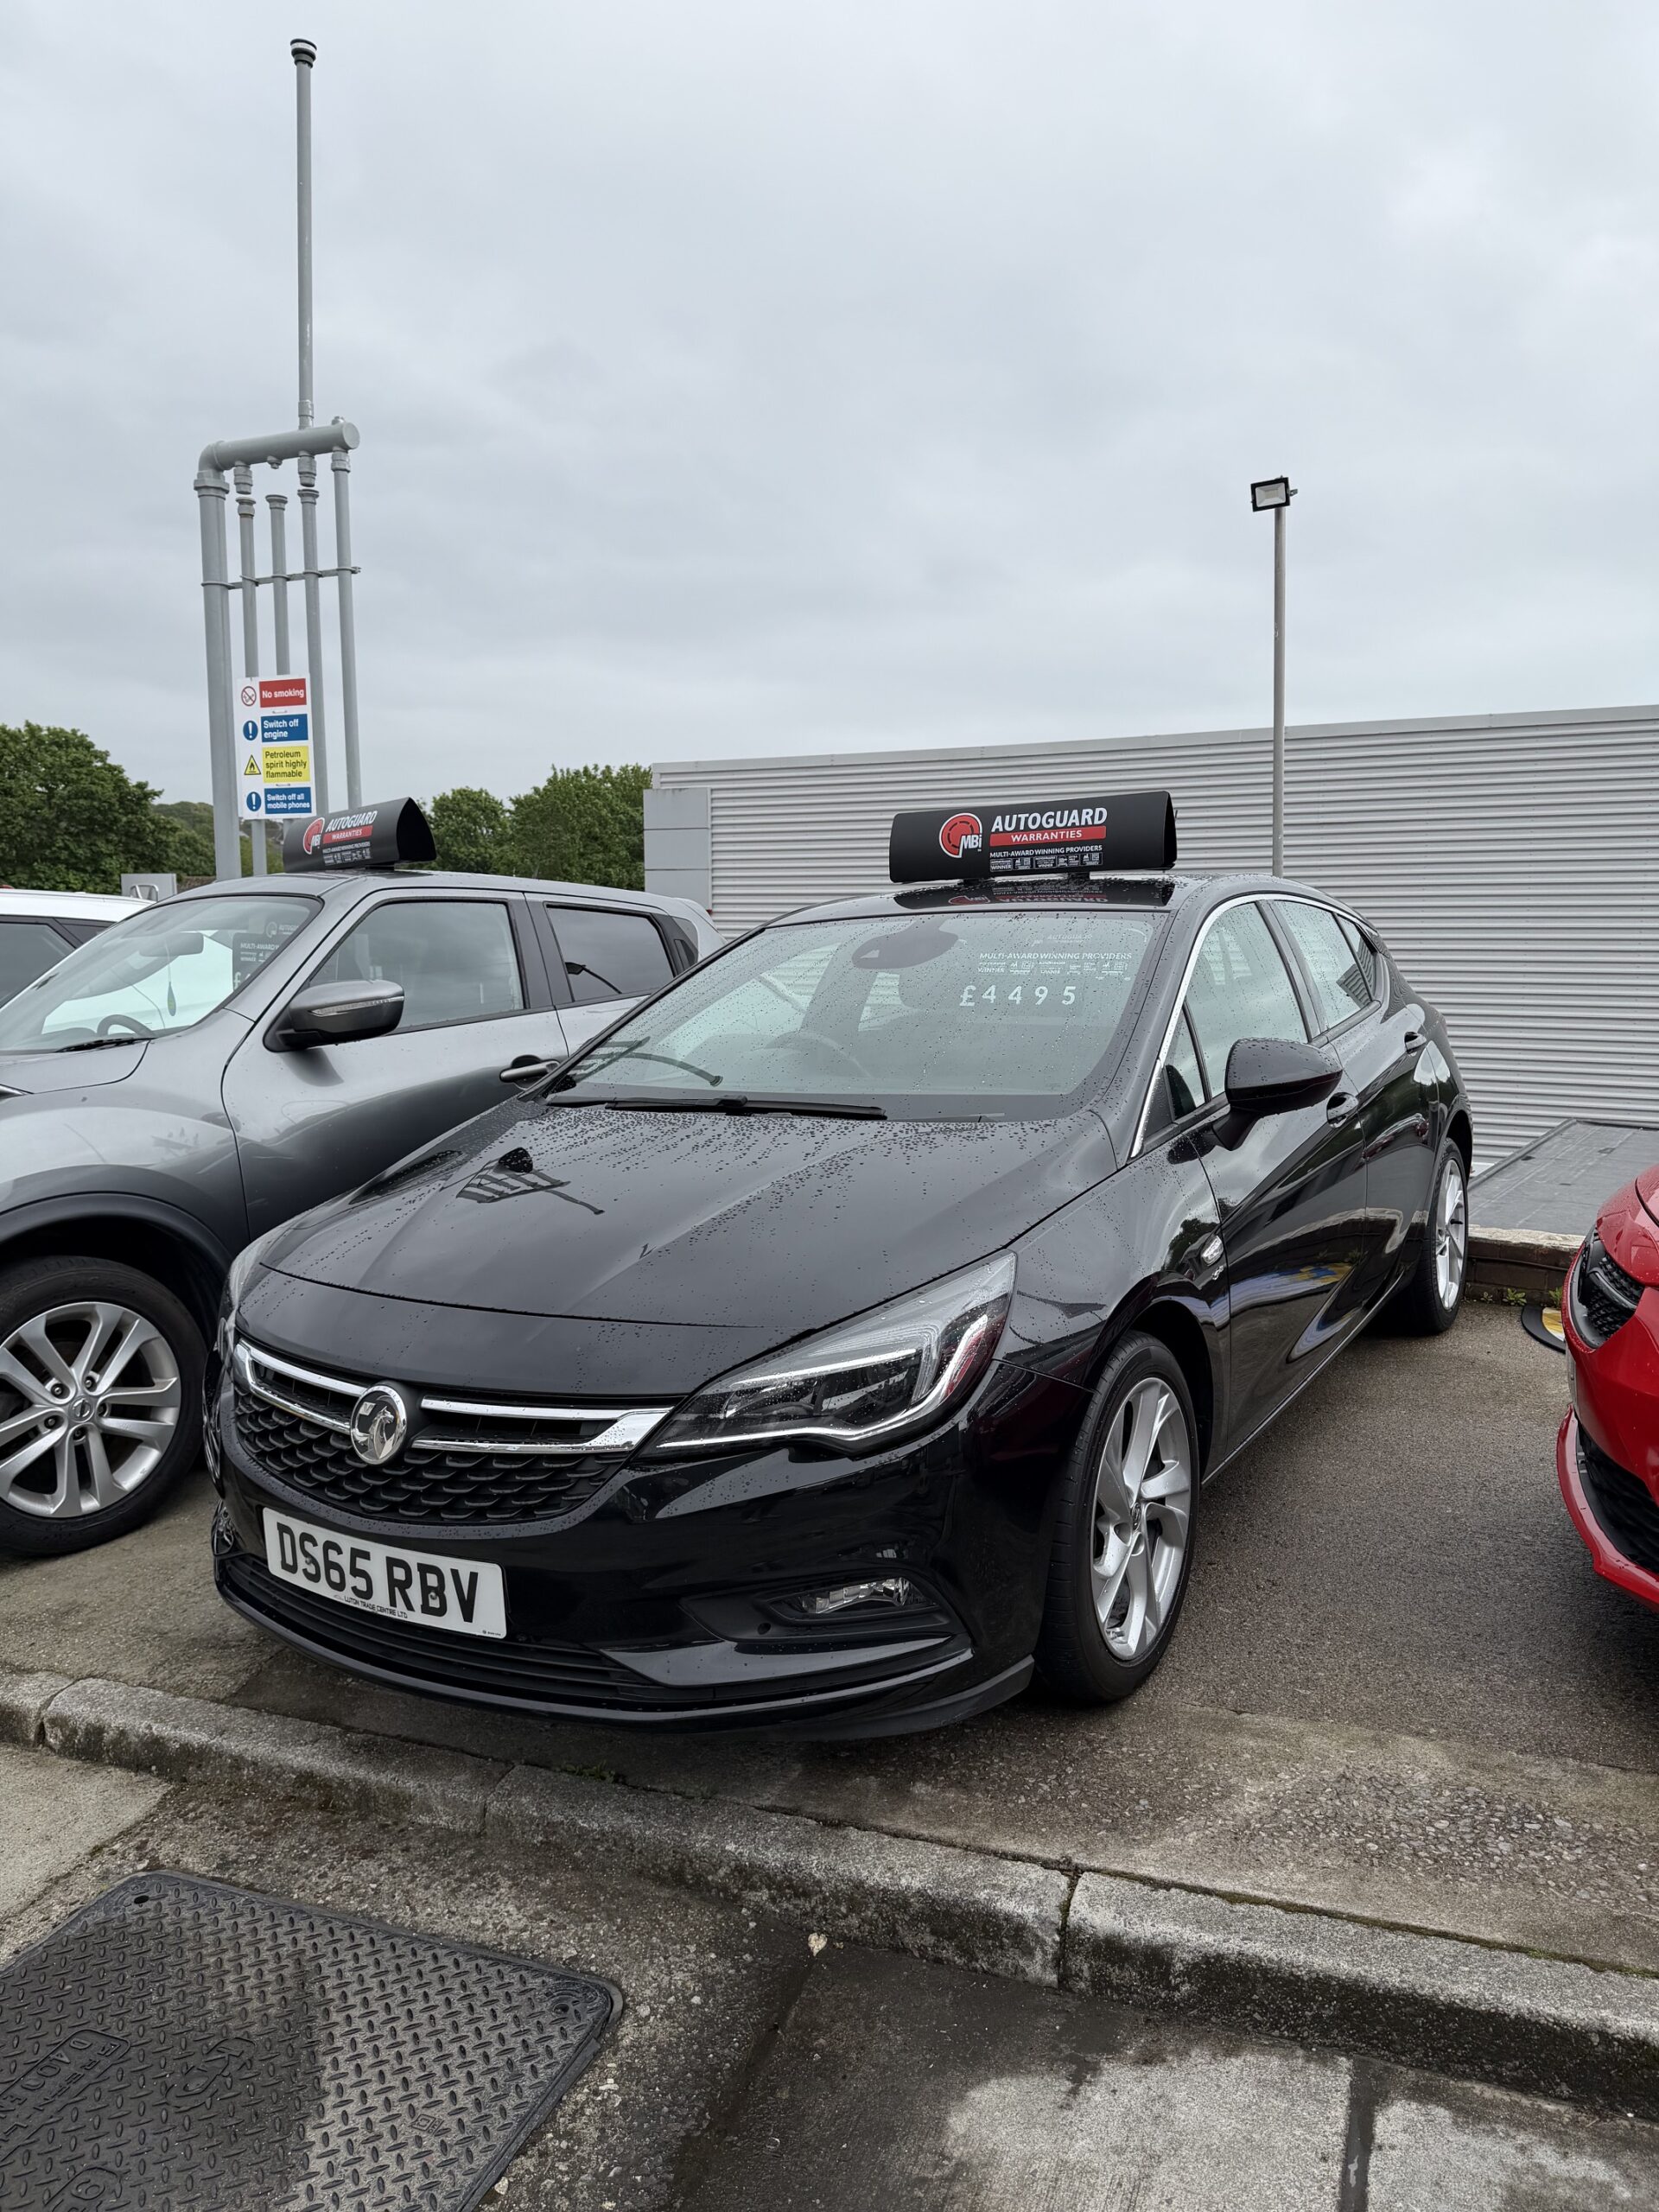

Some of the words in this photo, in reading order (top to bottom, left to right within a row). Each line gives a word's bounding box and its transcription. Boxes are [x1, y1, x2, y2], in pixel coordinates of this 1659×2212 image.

[262, 690, 272, 698] No
[274, 688, 304, 698] smoking
[264, 720, 288, 728] Switch
[264, 730, 289, 740] engine
[264, 750, 301, 759] Petroleum
[265, 760, 283, 770] spirit
[285, 760, 307, 769] highly
[325, 810, 378, 832] AUTOGUARD
[991, 807, 1108, 832] AUTOGUARD
[331, 829, 363, 840] WARRANTIES
[1011, 830, 1083, 842] WARRANTIES
[989, 849, 1034, 858] MULTI-AWARD
[1034, 847, 1065, 855] WINNING
[1065, 845, 1103, 854] PROVIDERS
[276, 1522, 373, 1600] DS65
[385, 1555, 479, 1623] RBV
[376, 1605, 397, 1616] CENTRE
